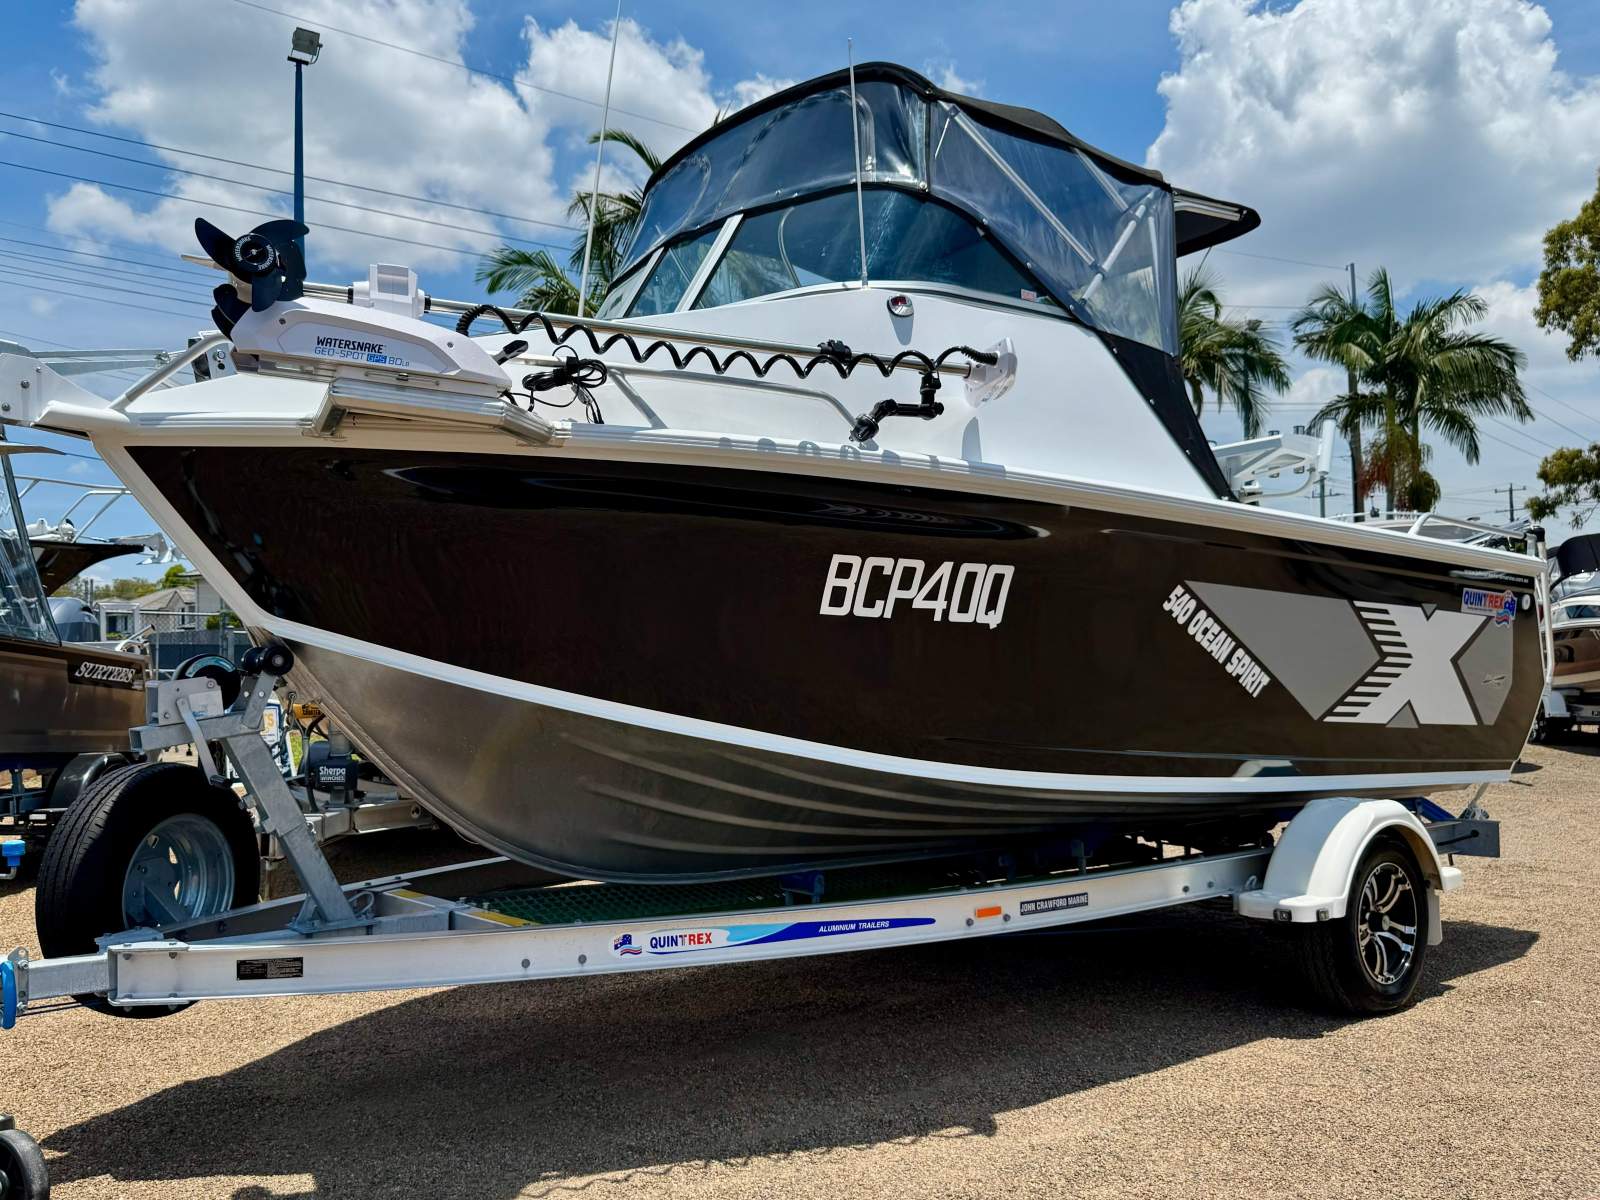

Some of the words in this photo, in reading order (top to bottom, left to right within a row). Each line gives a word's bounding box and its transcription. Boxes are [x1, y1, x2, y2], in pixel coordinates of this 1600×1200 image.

[316, 336, 384, 354] WATERSNAKE
[315, 346, 366, 360] GEO-SPOT
[367, 354, 387, 364] GPS
[819, 554, 1016, 630] BCP40Q
[1463, 590, 1505, 610] QUINTREX
[1162, 584, 1197, 625] 540
[1187, 609, 1236, 664] OCEAN
[1225, 647, 1271, 698] SPIRIT
[75, 661, 136, 683] SURTEES
[319, 766, 346, 776] Sherpa
[1021, 902, 1036, 913] JOHN
[1036, 898, 1067, 910] CRAWFORD
[1067, 894, 1088, 905] MARINE
[819, 923, 857, 933] ALUMINIUM
[858, 920, 890, 930] TRAILERS
[650, 932, 712, 949] QUINTREX
